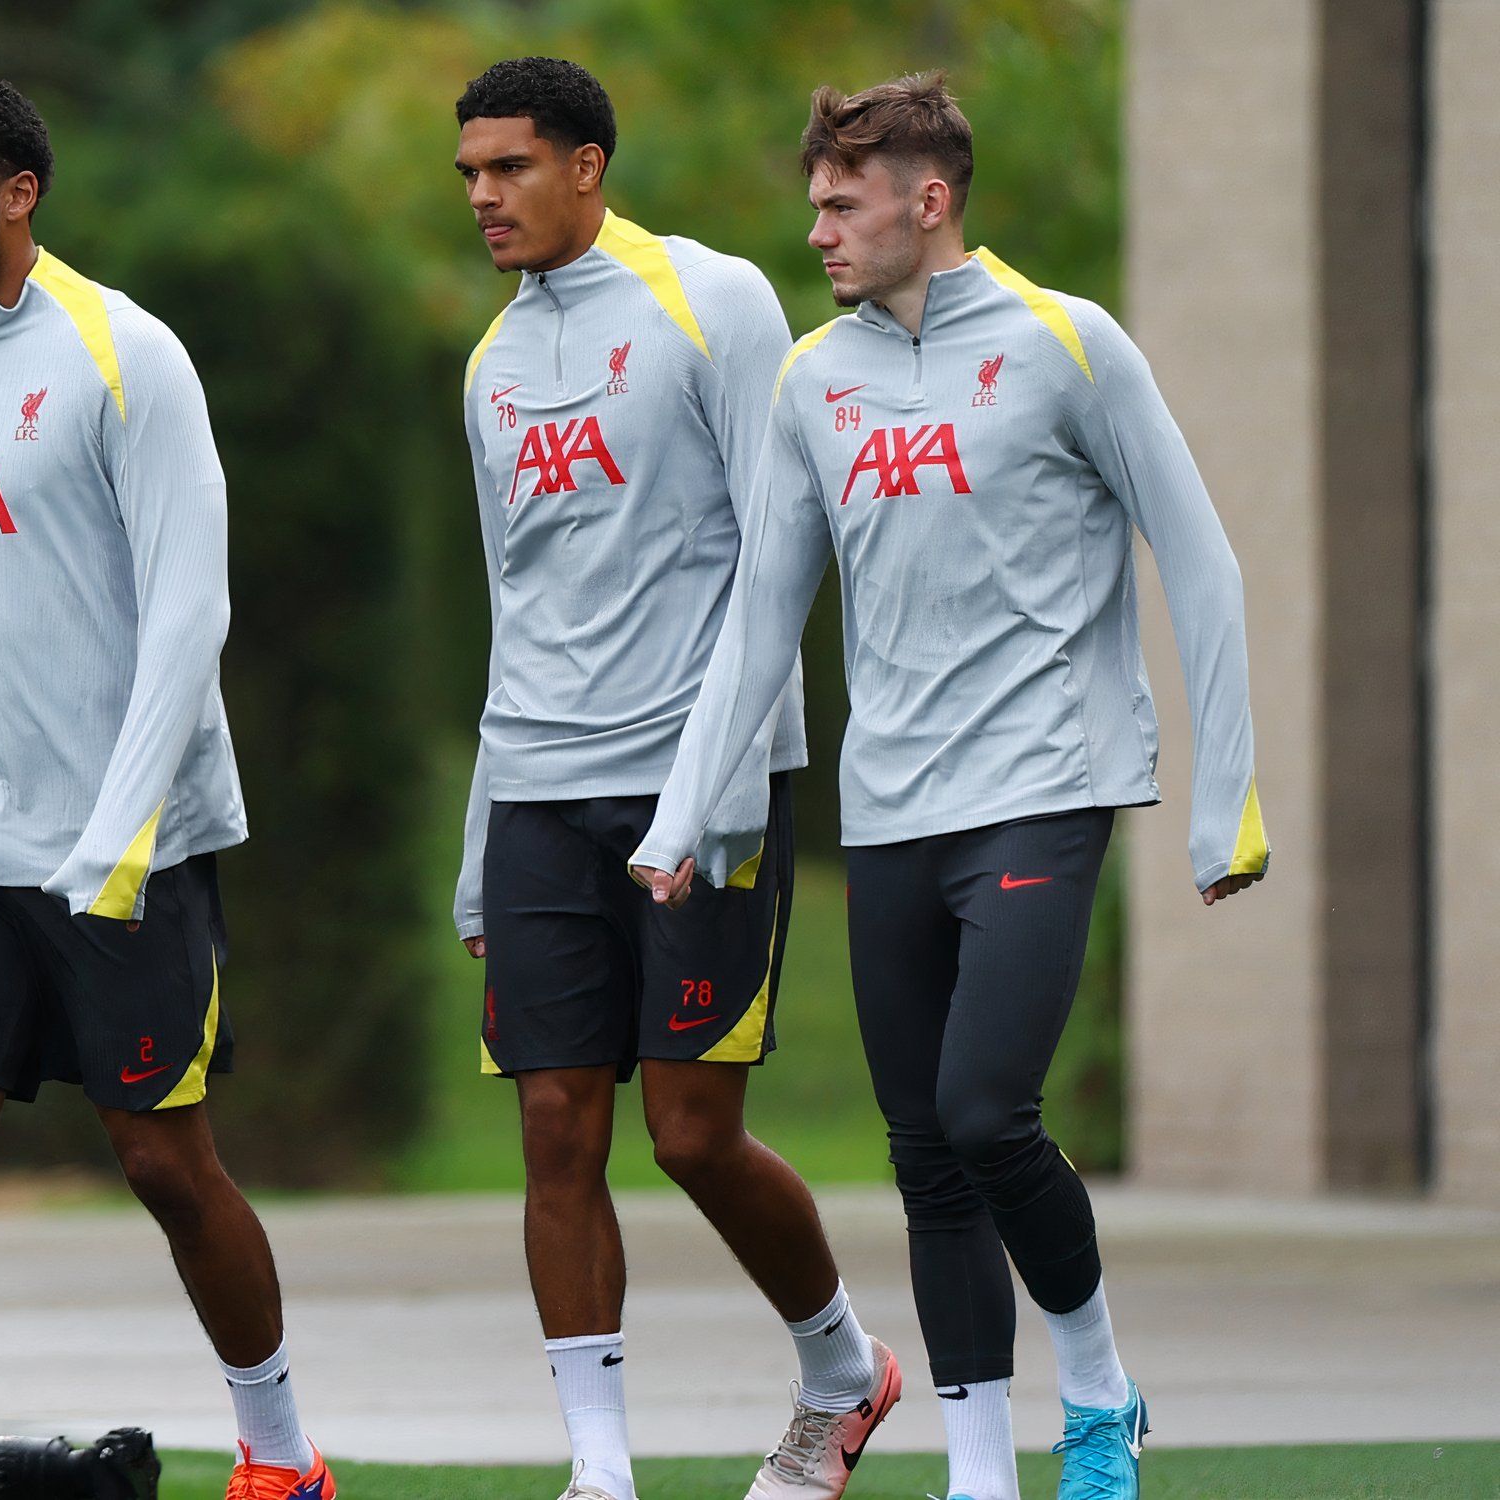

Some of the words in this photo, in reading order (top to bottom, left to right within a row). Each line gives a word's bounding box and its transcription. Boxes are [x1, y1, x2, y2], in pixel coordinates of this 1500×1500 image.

[497, 403, 517, 431] 78
[835, 405, 862, 432] 84
[508, 415, 625, 504] AXA
[839, 422, 971, 506] AXA
[681, 979, 713, 1007] 78
[141, 1036, 155, 1063] 2
